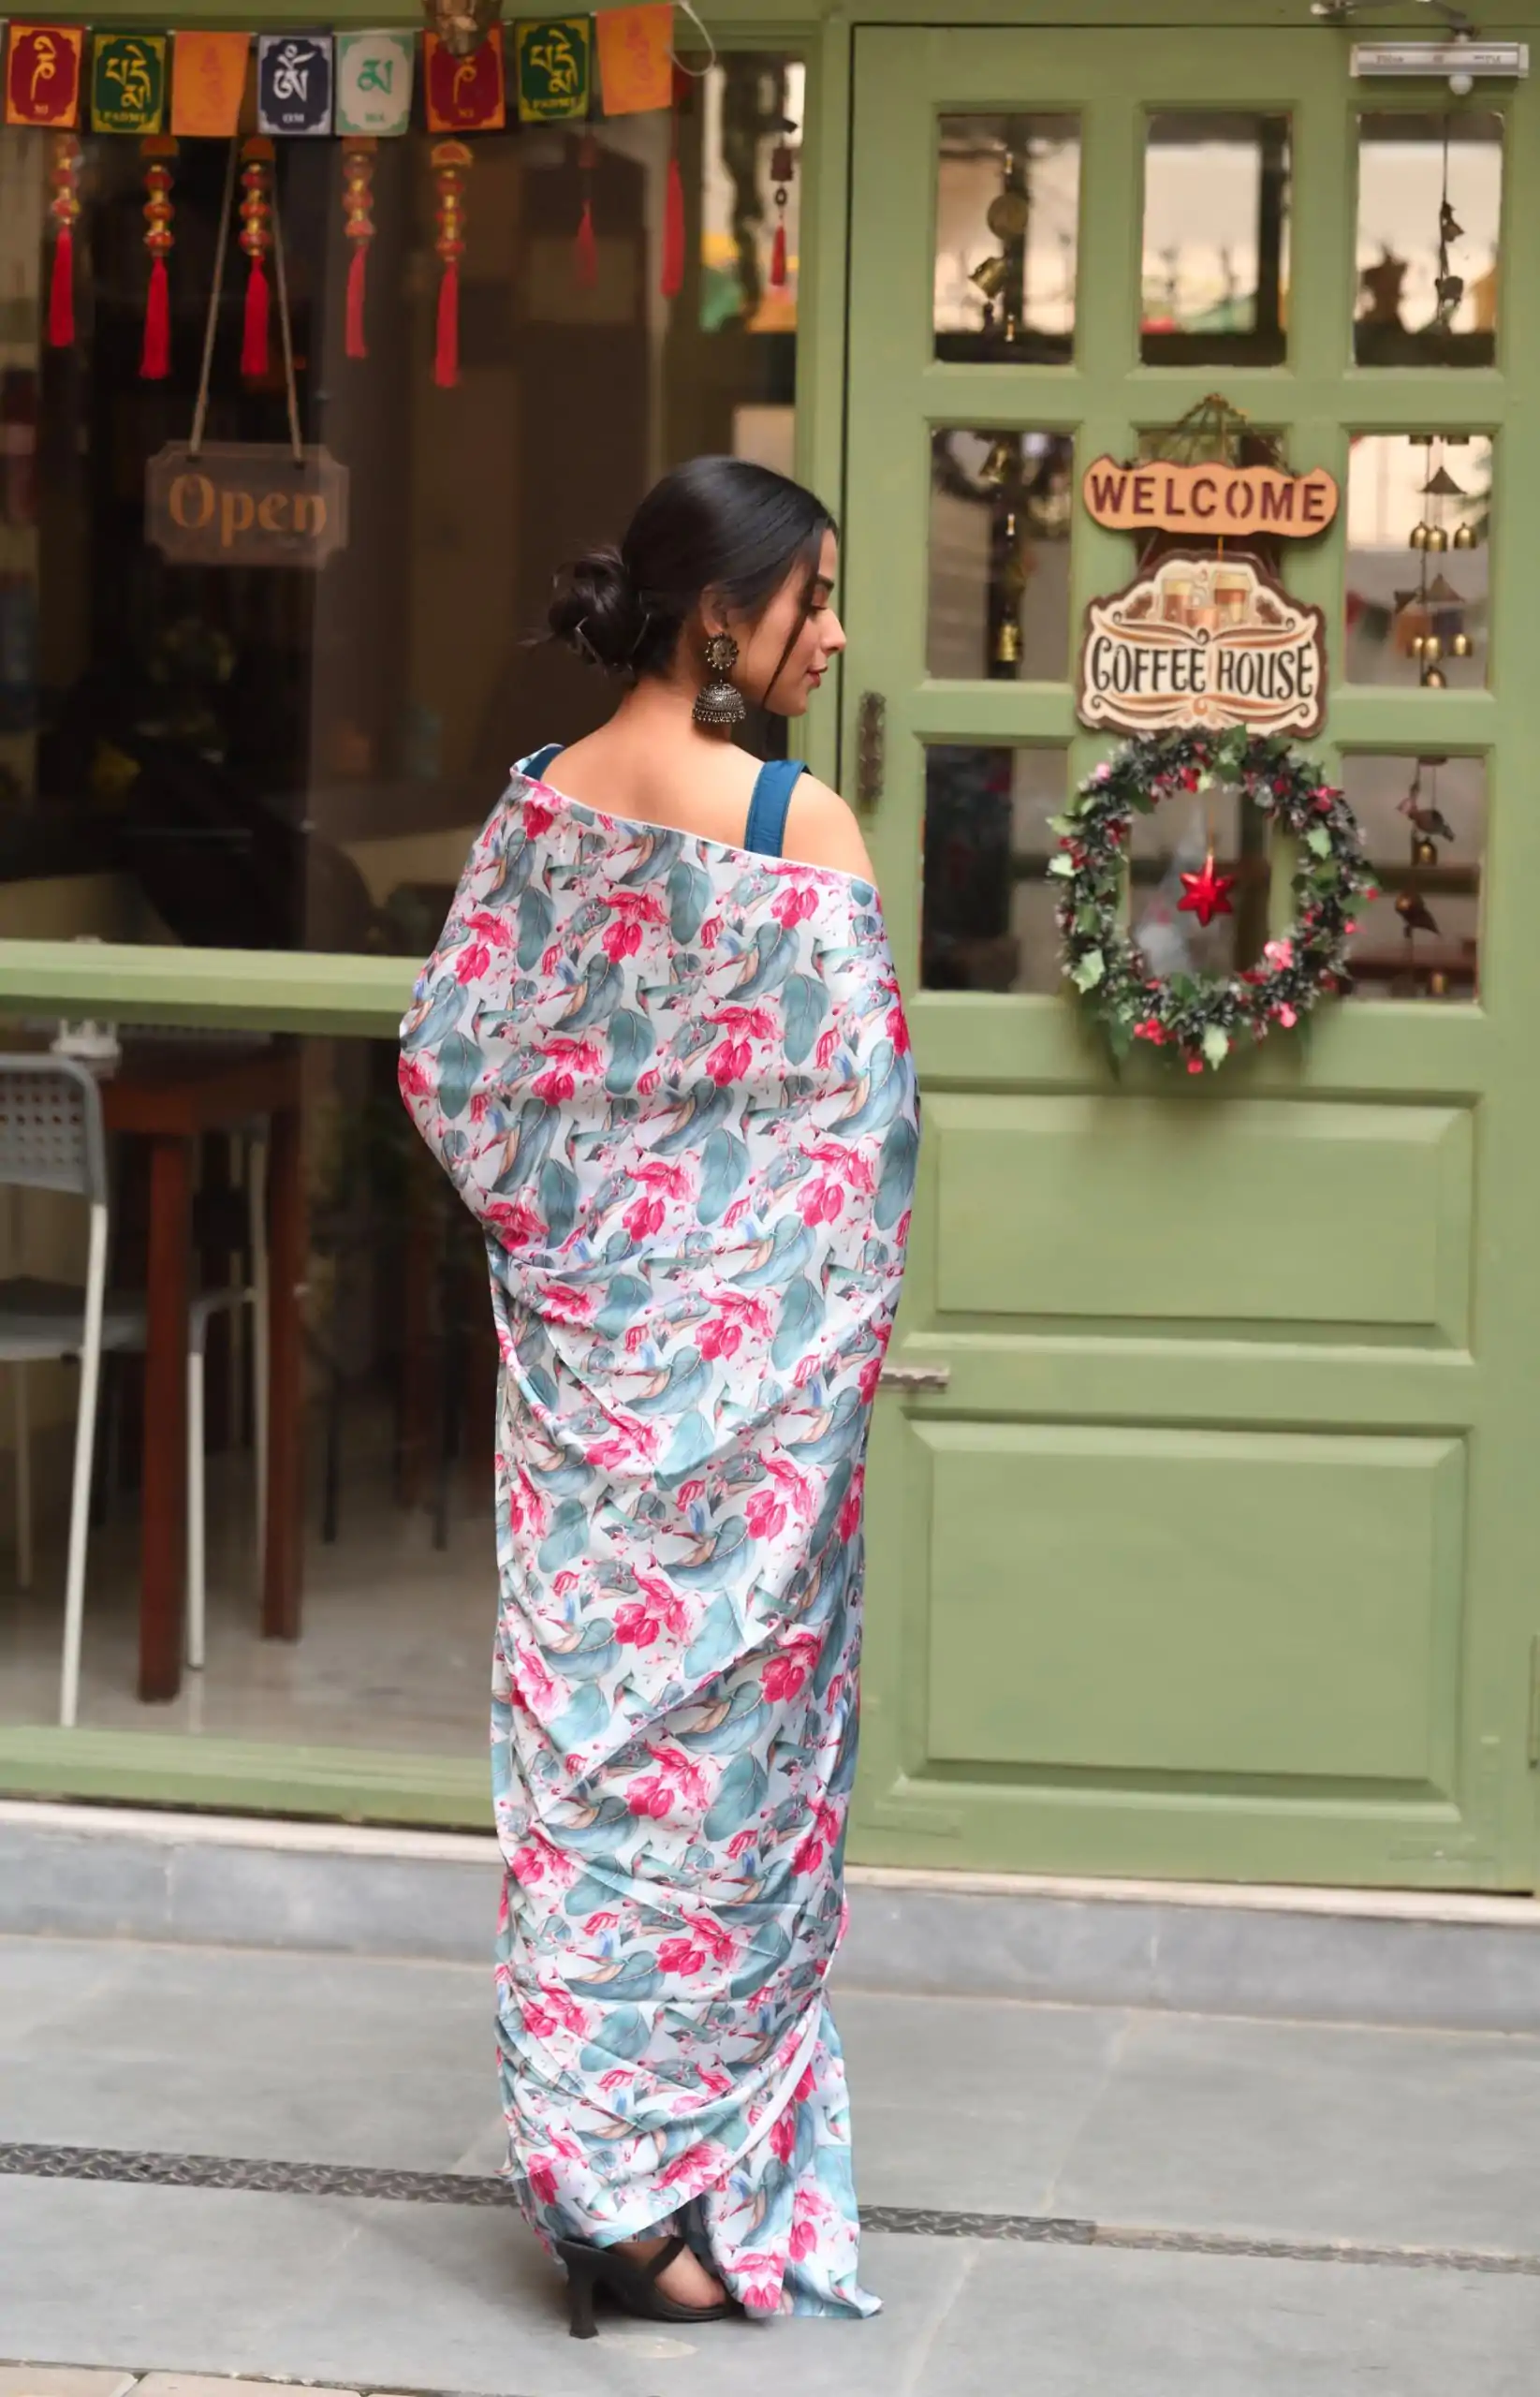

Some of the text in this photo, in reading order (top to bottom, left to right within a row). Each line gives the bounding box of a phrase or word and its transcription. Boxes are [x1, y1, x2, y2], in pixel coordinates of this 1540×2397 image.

[169, 474, 328, 548] Open
[1092, 475, 1327, 522] WELCOME
[1092, 636, 1206, 693] COFFEE
